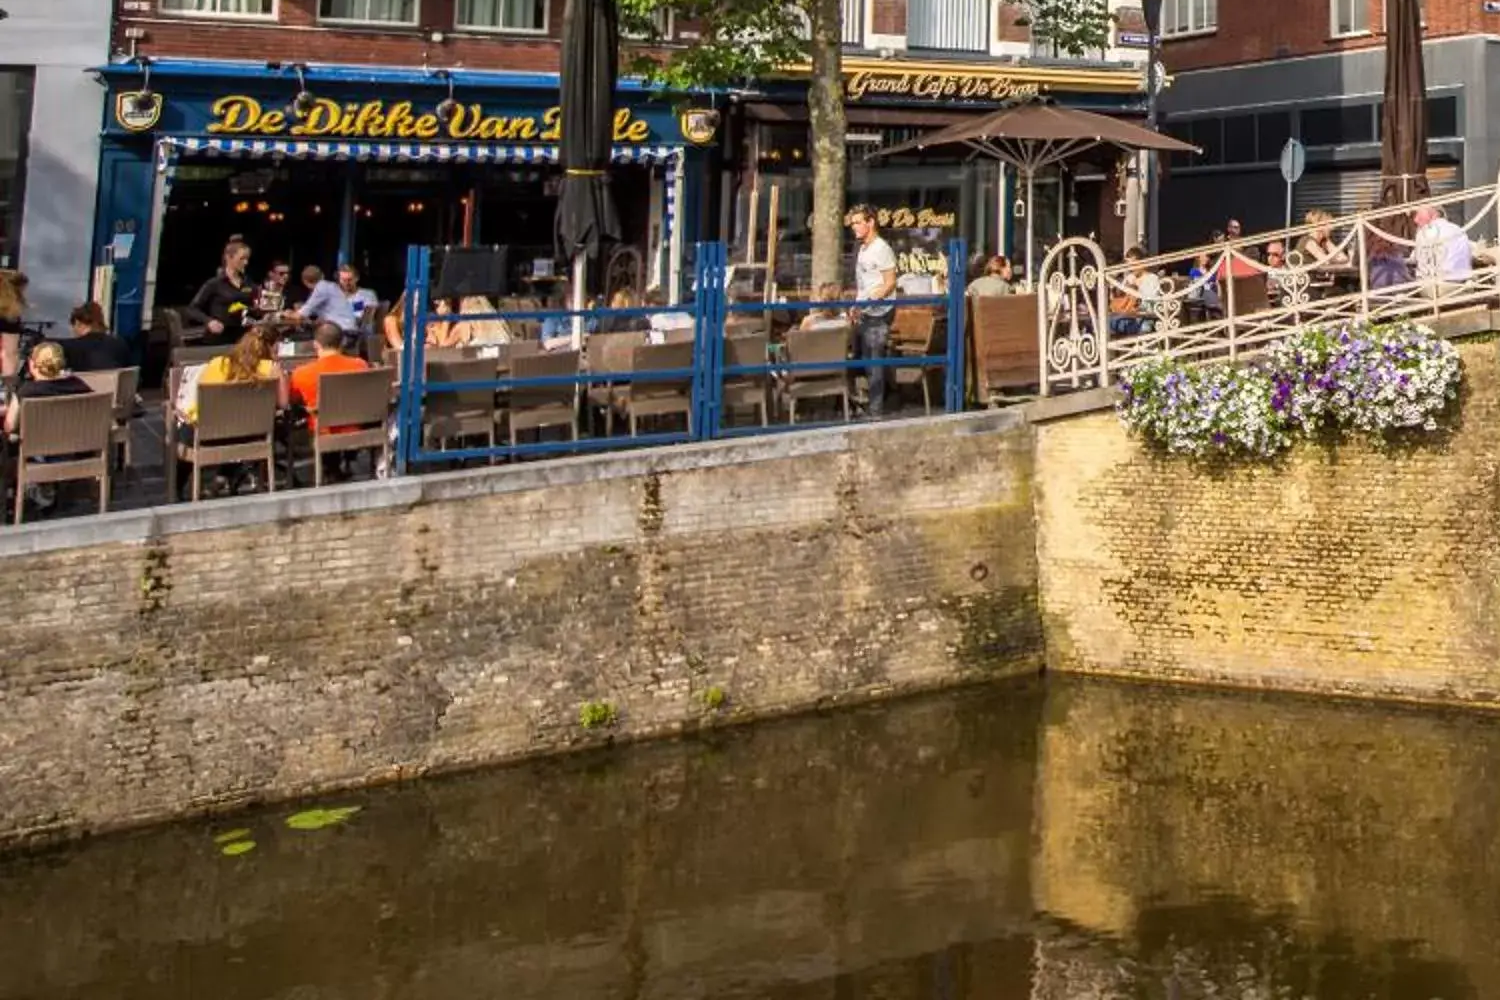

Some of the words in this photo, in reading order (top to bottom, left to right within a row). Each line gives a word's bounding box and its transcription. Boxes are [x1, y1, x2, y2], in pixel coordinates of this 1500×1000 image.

[848, 71, 911, 101] Grand
[207, 95, 287, 133] De
[444, 103, 538, 140] Van
